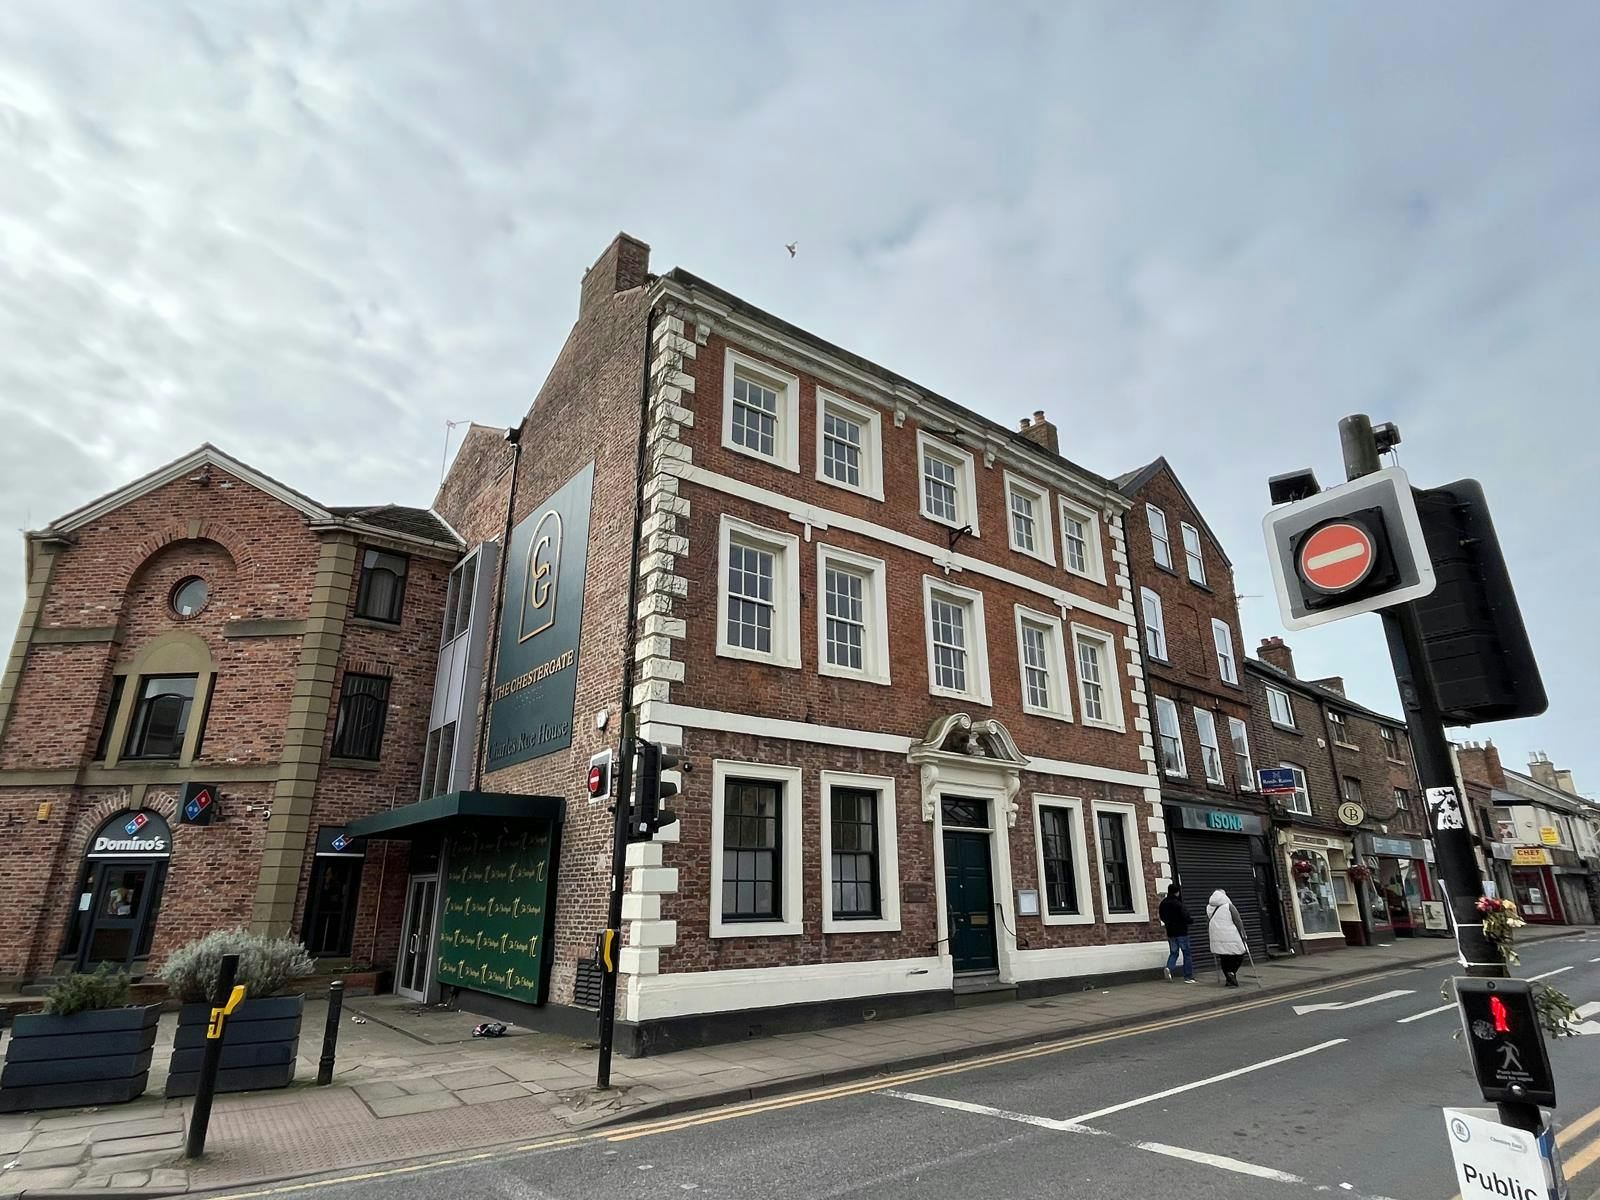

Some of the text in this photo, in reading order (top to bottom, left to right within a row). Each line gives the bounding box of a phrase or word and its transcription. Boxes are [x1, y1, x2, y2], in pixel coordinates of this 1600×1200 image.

[495, 649, 575, 700] THE CHESTERGATE
[538, 721, 568, 745] House
[94, 836, 165, 850] Domino's
[1463, 1162, 1538, 1200] Public
